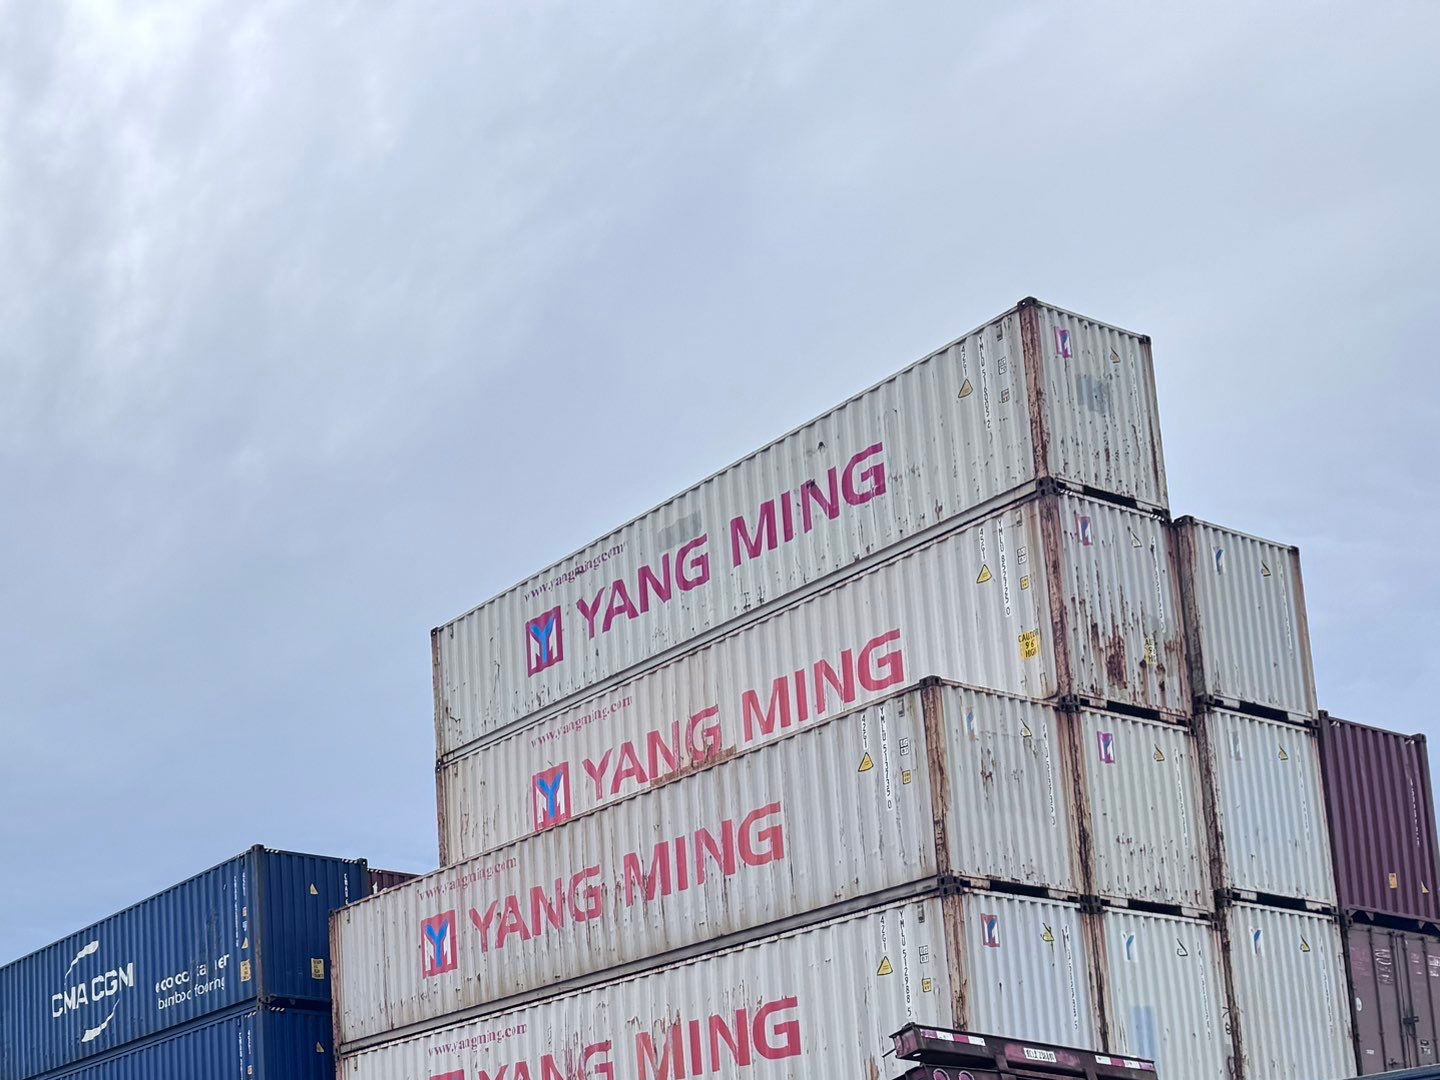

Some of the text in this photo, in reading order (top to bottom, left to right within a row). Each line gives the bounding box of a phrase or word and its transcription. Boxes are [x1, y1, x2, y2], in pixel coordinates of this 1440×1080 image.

[576, 442, 886, 640] YANG MING
[582, 628, 905, 800] YANG MING
[469, 802, 785, 952] YANG MING
[52, 962, 134, 1018] CMA CGM
[428, 1022, 528, 1057] www.yangming.com
